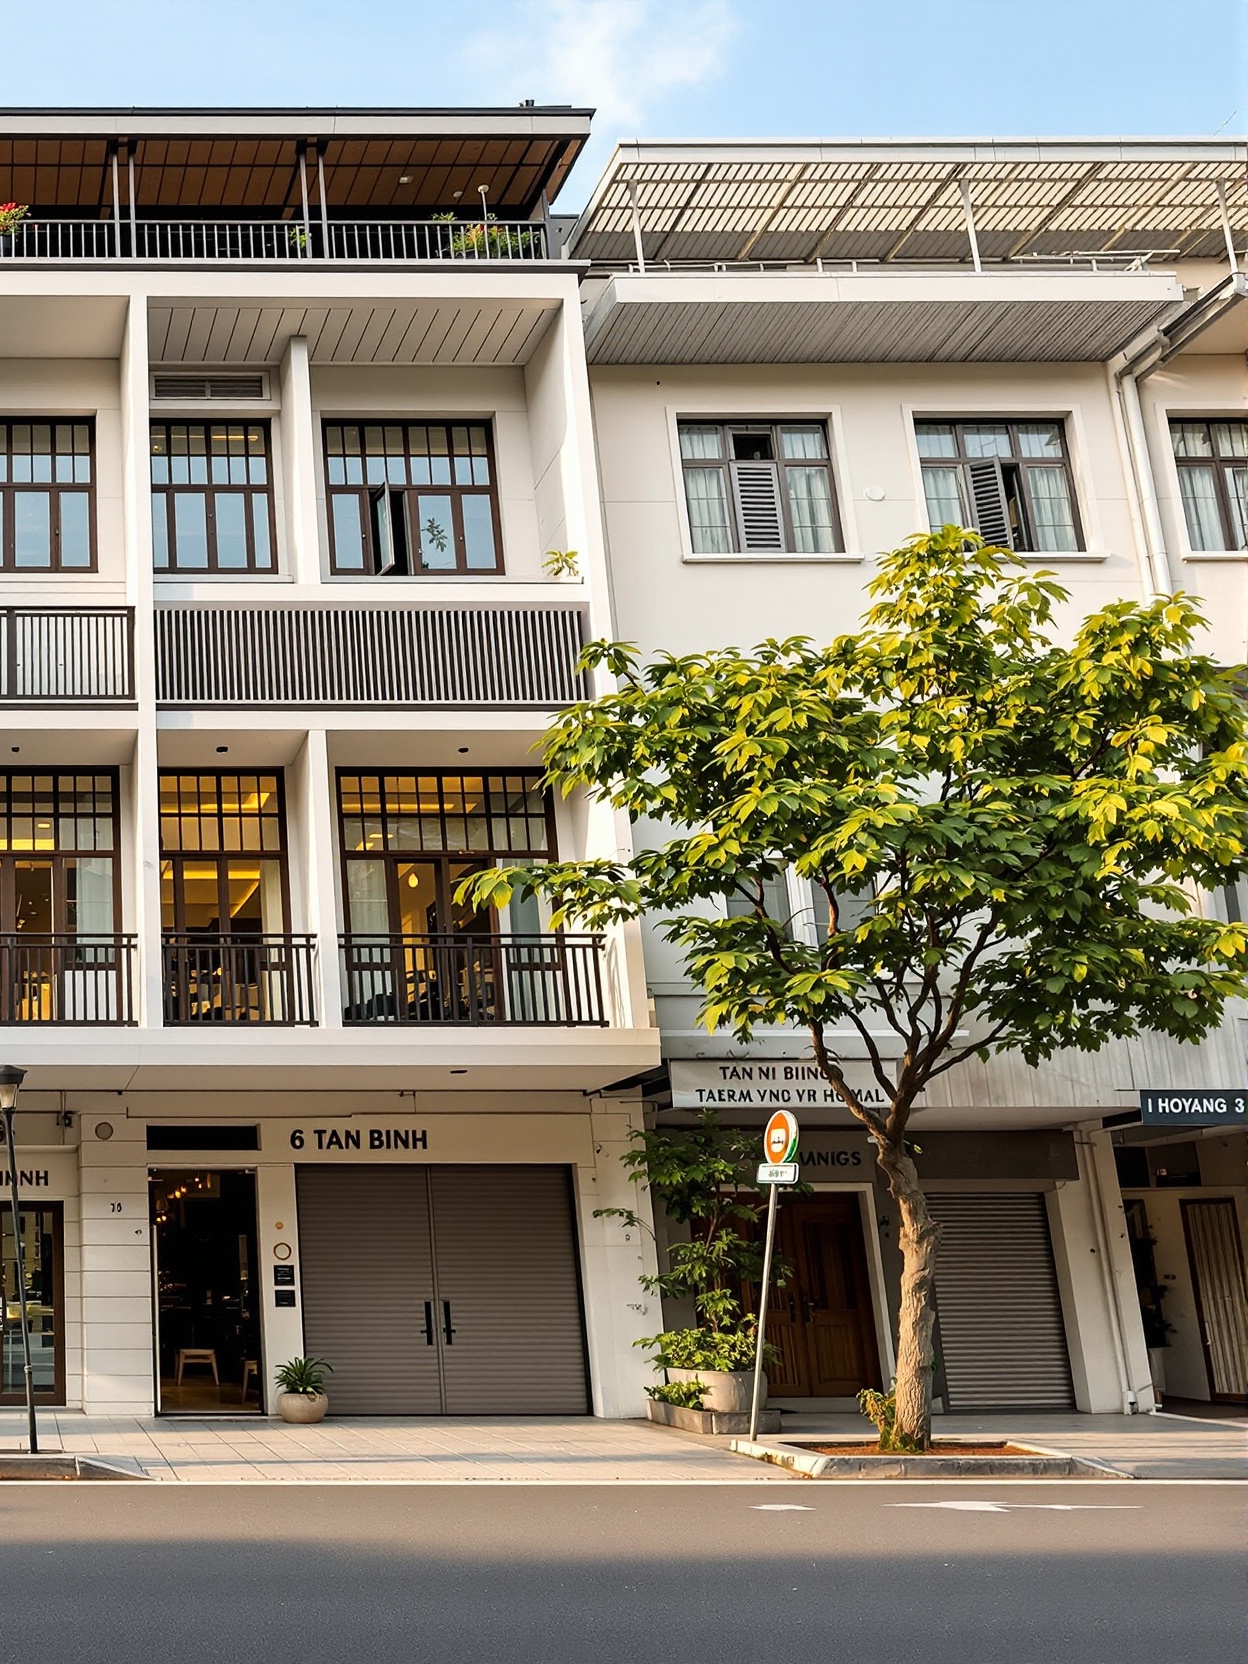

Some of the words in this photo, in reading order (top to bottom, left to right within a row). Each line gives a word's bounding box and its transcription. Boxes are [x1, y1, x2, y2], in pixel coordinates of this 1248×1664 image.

[719, 1066, 753, 1080] TAN
[758, 1066, 777, 1080] NI
[695, 1088, 754, 1102] TAERM
[1158, 1097, 1228, 1114] HOYANG
[1235, 1097, 1245, 1113] 3
[290, 1129, 305, 1150] 6
[313, 1129, 361, 1150] TAN
[369, 1129, 428, 1150] BINH
